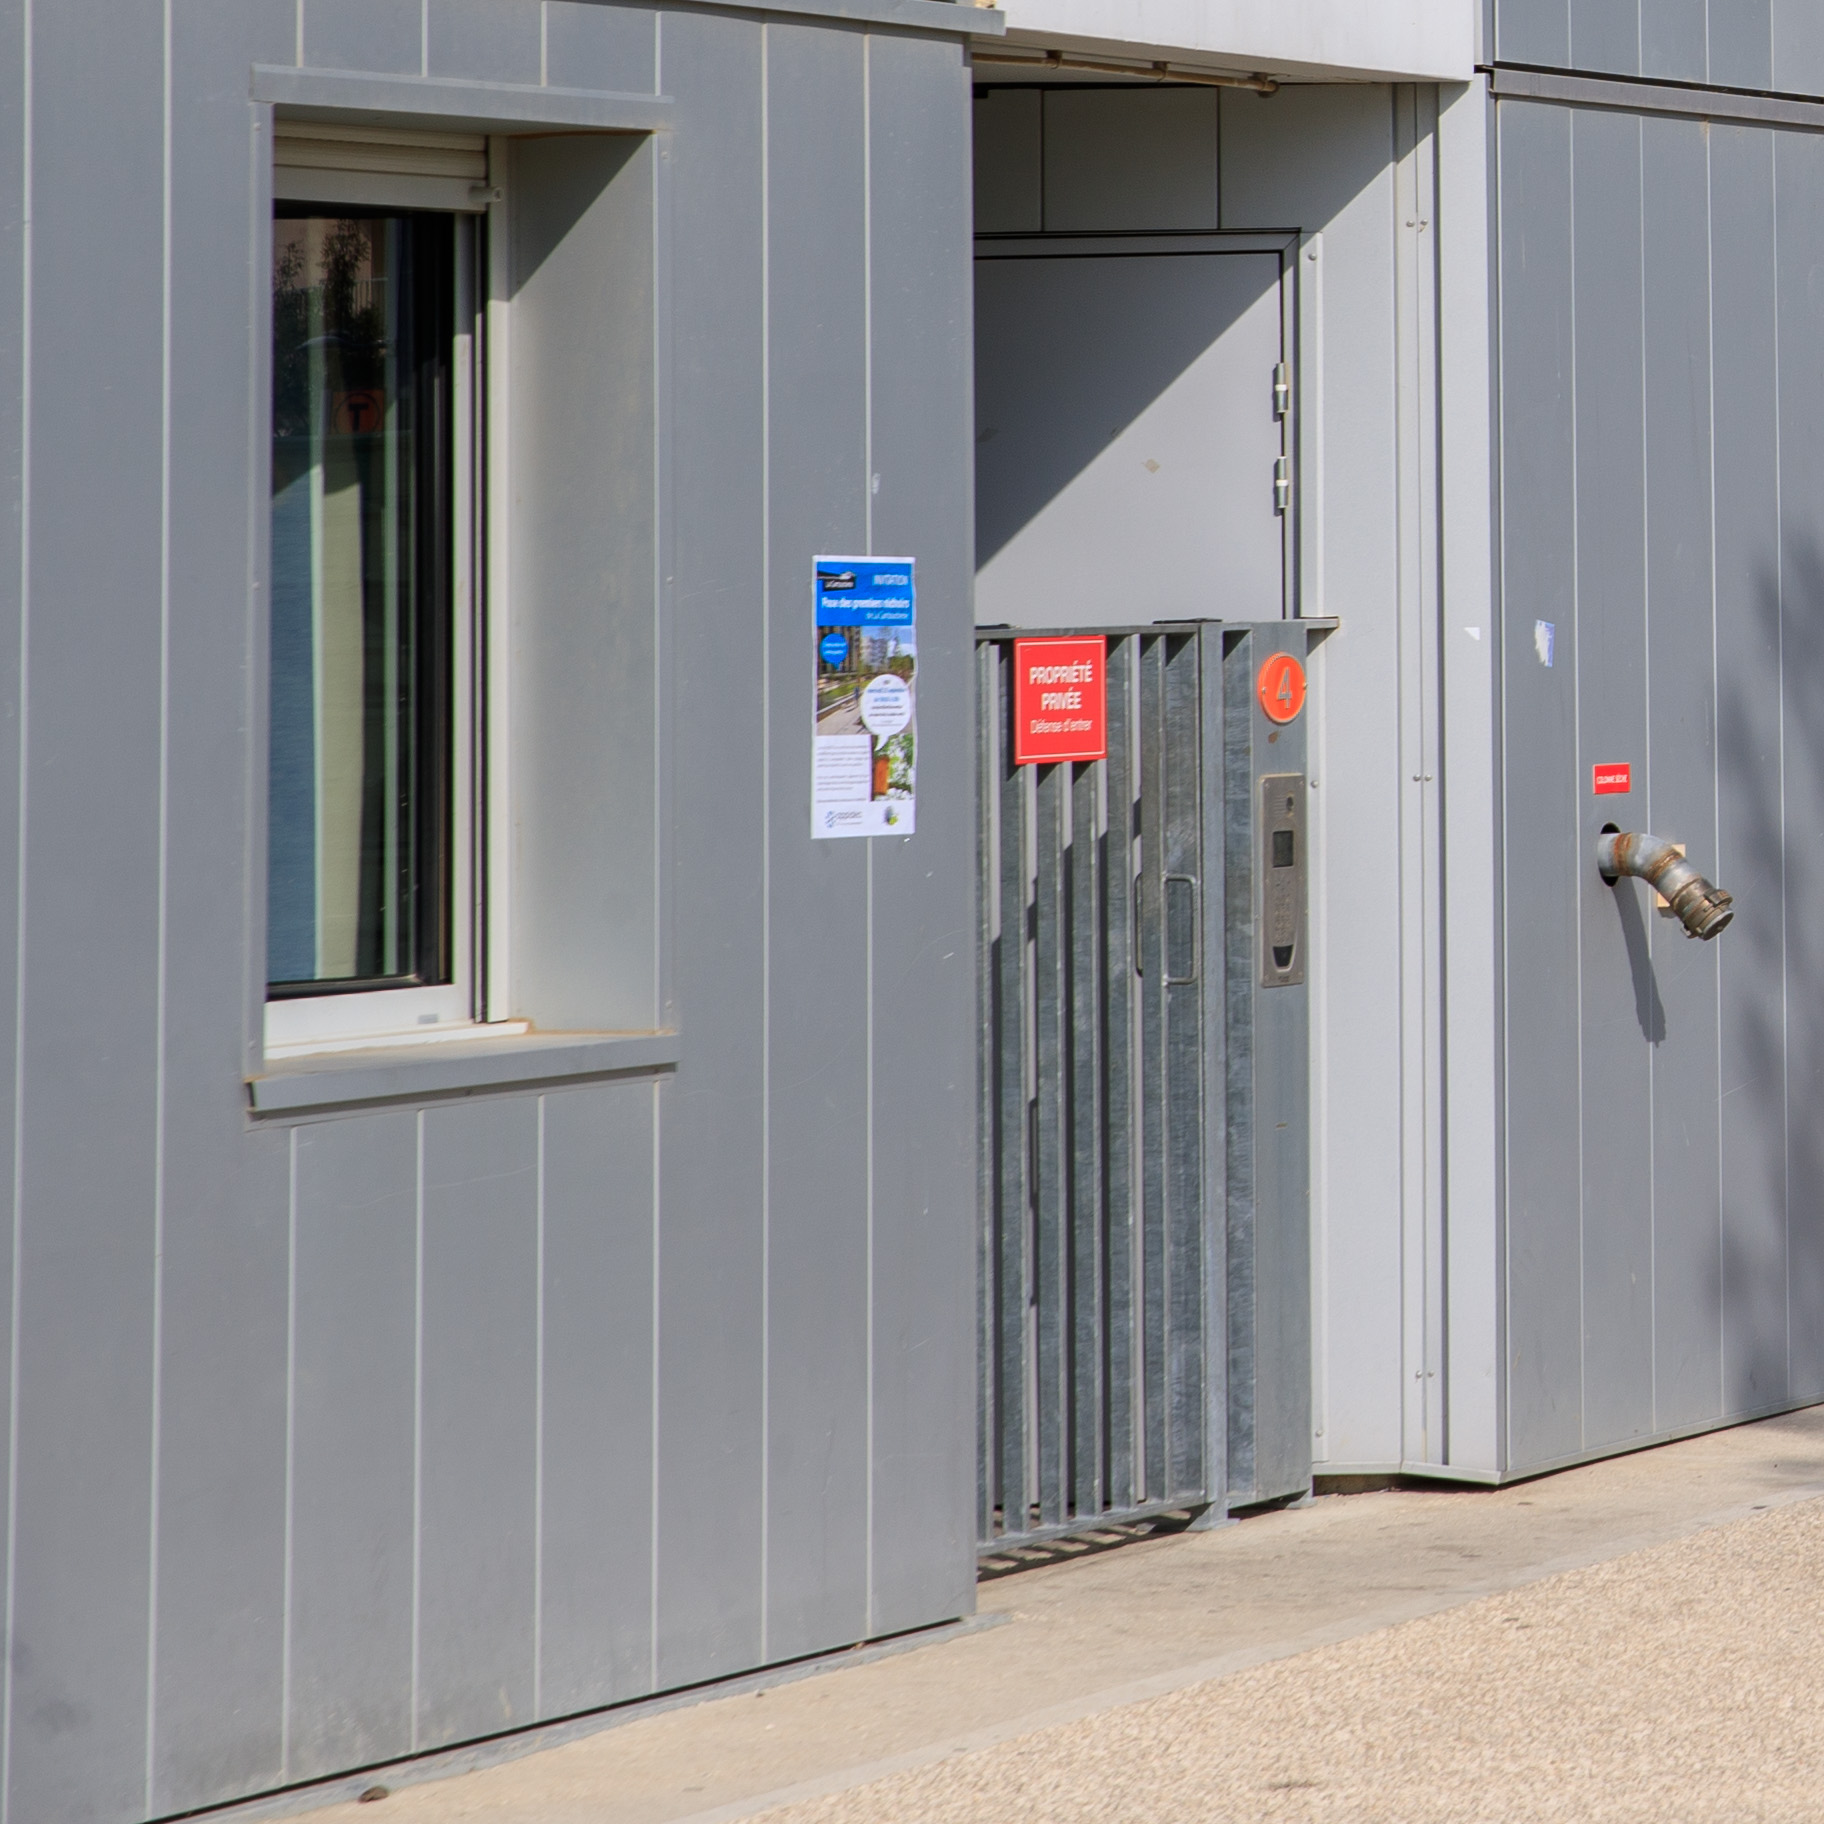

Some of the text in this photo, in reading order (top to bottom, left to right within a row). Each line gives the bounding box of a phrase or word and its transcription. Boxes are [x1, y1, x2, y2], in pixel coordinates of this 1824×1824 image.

[1029, 659, 1093, 685] PROPRIÉTÉ
[1041, 686, 1082, 711] PRIVÉE
[1277, 666, 1292, 709] 4
[1030, 718, 1093, 734] Défense d'entrer
